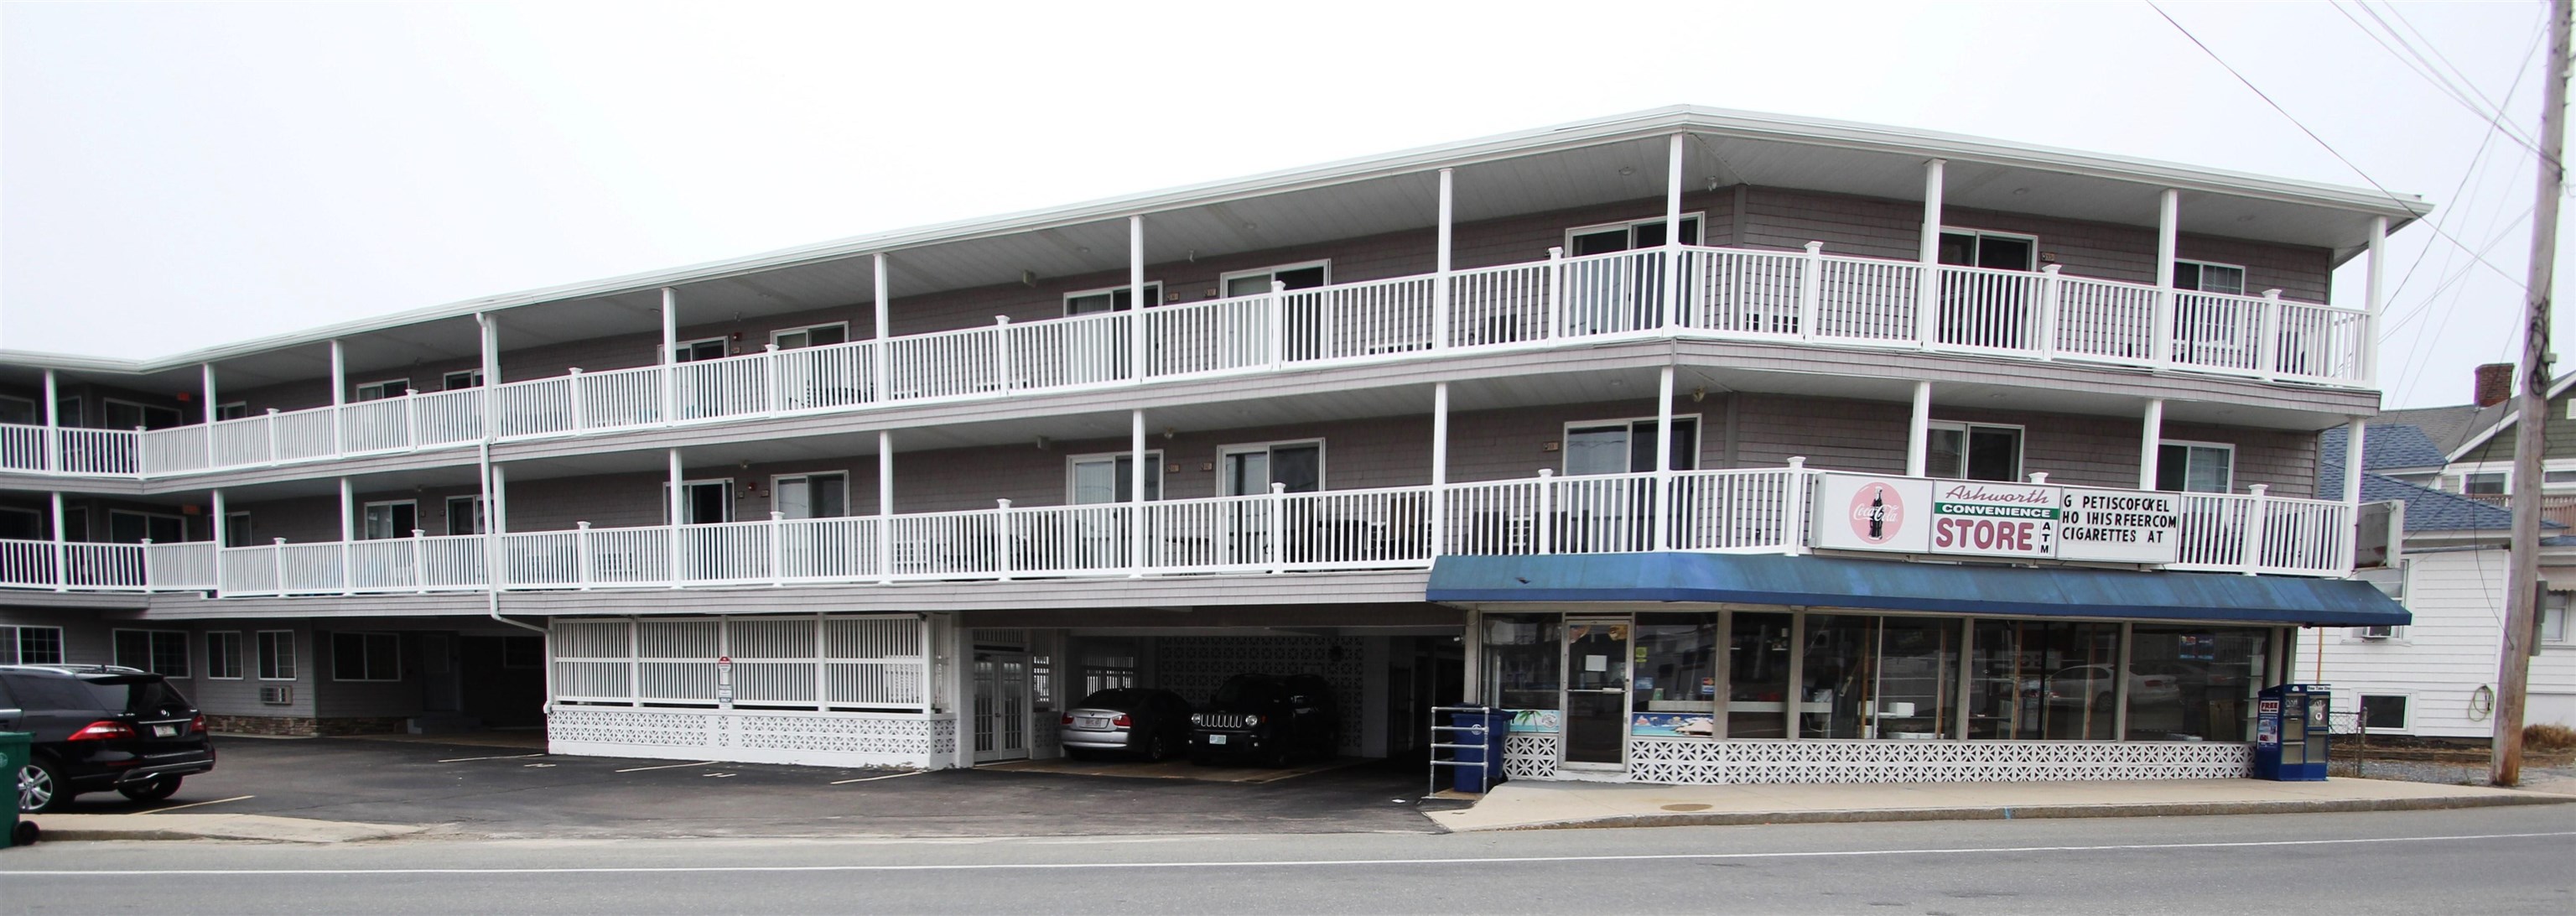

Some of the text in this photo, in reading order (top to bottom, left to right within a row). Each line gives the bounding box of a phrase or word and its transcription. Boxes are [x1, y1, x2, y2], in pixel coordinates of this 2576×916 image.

[1945, 485, 2049, 503] Ashworth
[2064, 495, 2072, 507] G
[1942, 504, 2051, 518] CONVENIENCE
[2063, 511, 2080, 524] HO
[1935, 518, 2034, 551] STORE
[2040, 522, 2051, 554] ATM
[2063, 527, 2163, 544] CIGARETTES AT
